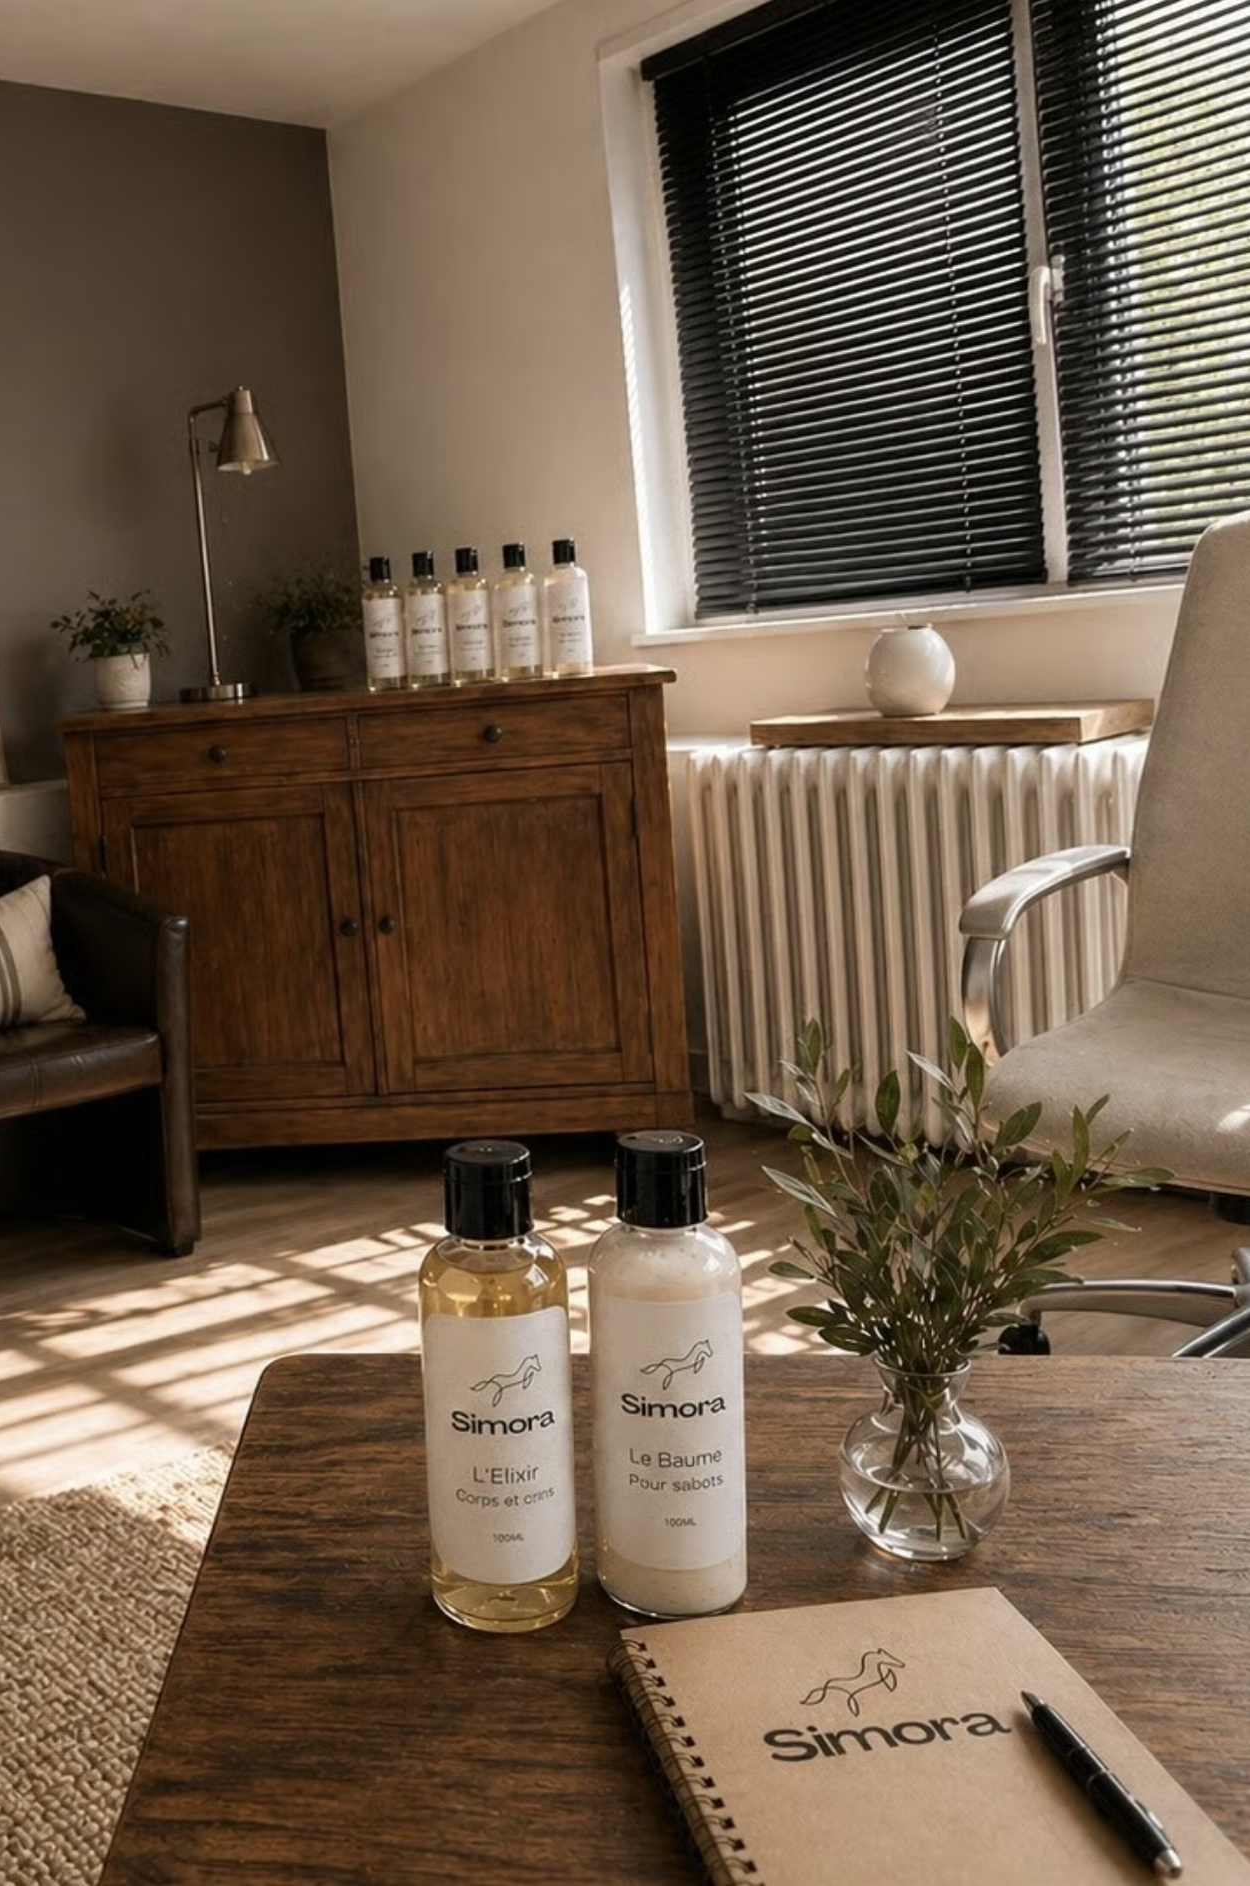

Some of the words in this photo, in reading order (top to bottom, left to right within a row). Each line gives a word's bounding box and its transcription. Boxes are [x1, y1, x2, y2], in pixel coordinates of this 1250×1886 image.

[622, 1394, 726, 1418] Simora
[452, 1411, 555, 1435] Simora
[630, 1449, 651, 1467] Le
[658, 1451, 722, 1468] Baume
[473, 1465, 538, 1484] L'Elixir
[629, 1474, 667, 1490] Pour
[672, 1475, 724, 1492] sabots
[456, 1488, 499, 1508] Corps
[504, 1495, 519, 1507] et
[764, 1713, 1012, 1762] Simora
